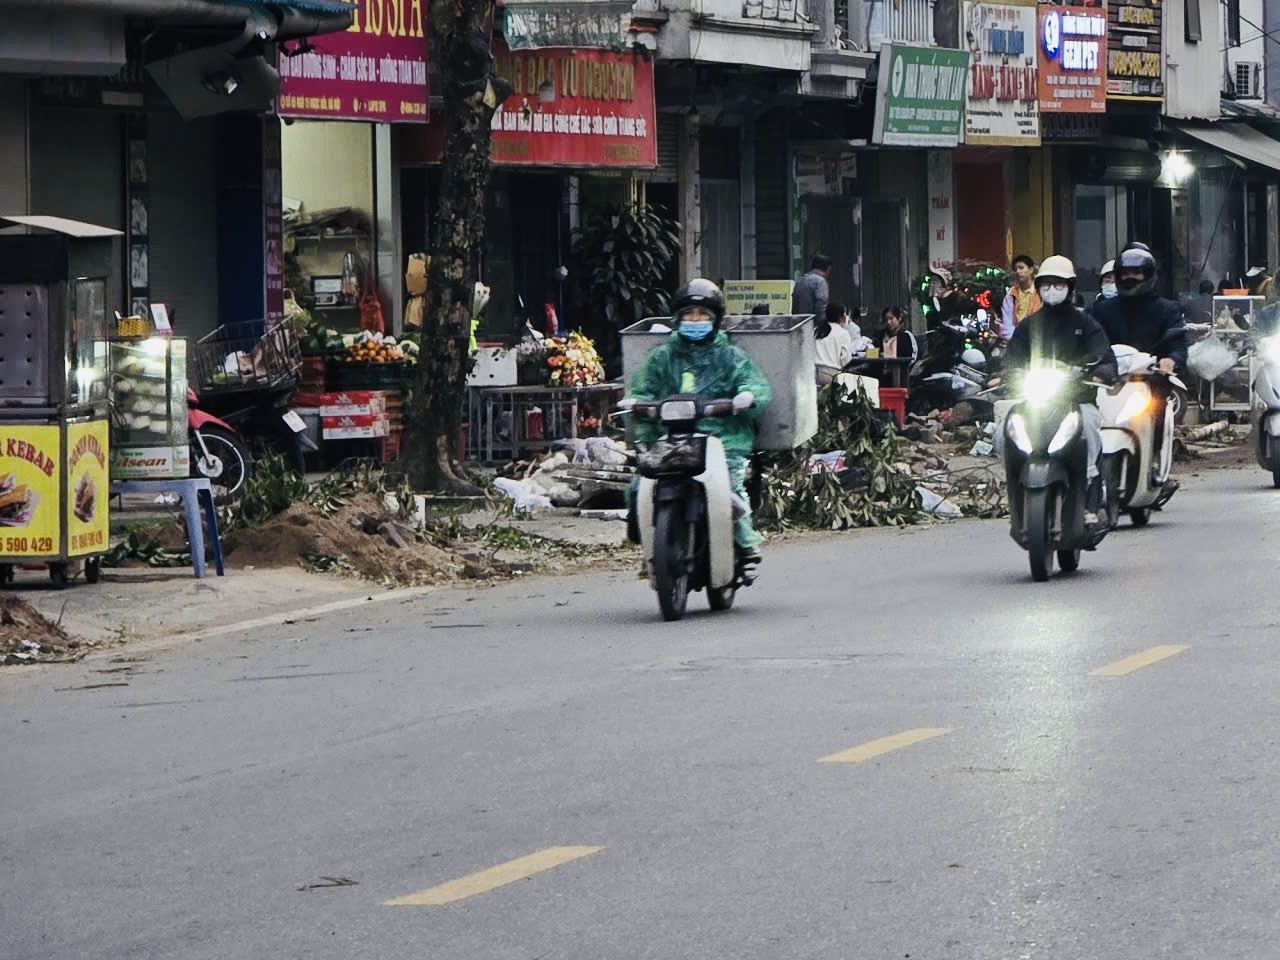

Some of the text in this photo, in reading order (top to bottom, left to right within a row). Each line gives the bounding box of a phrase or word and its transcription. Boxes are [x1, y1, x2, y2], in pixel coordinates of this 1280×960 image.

[6, 437, 55, 478] KEBAB
[6, 537, 53, 552] 590 429
